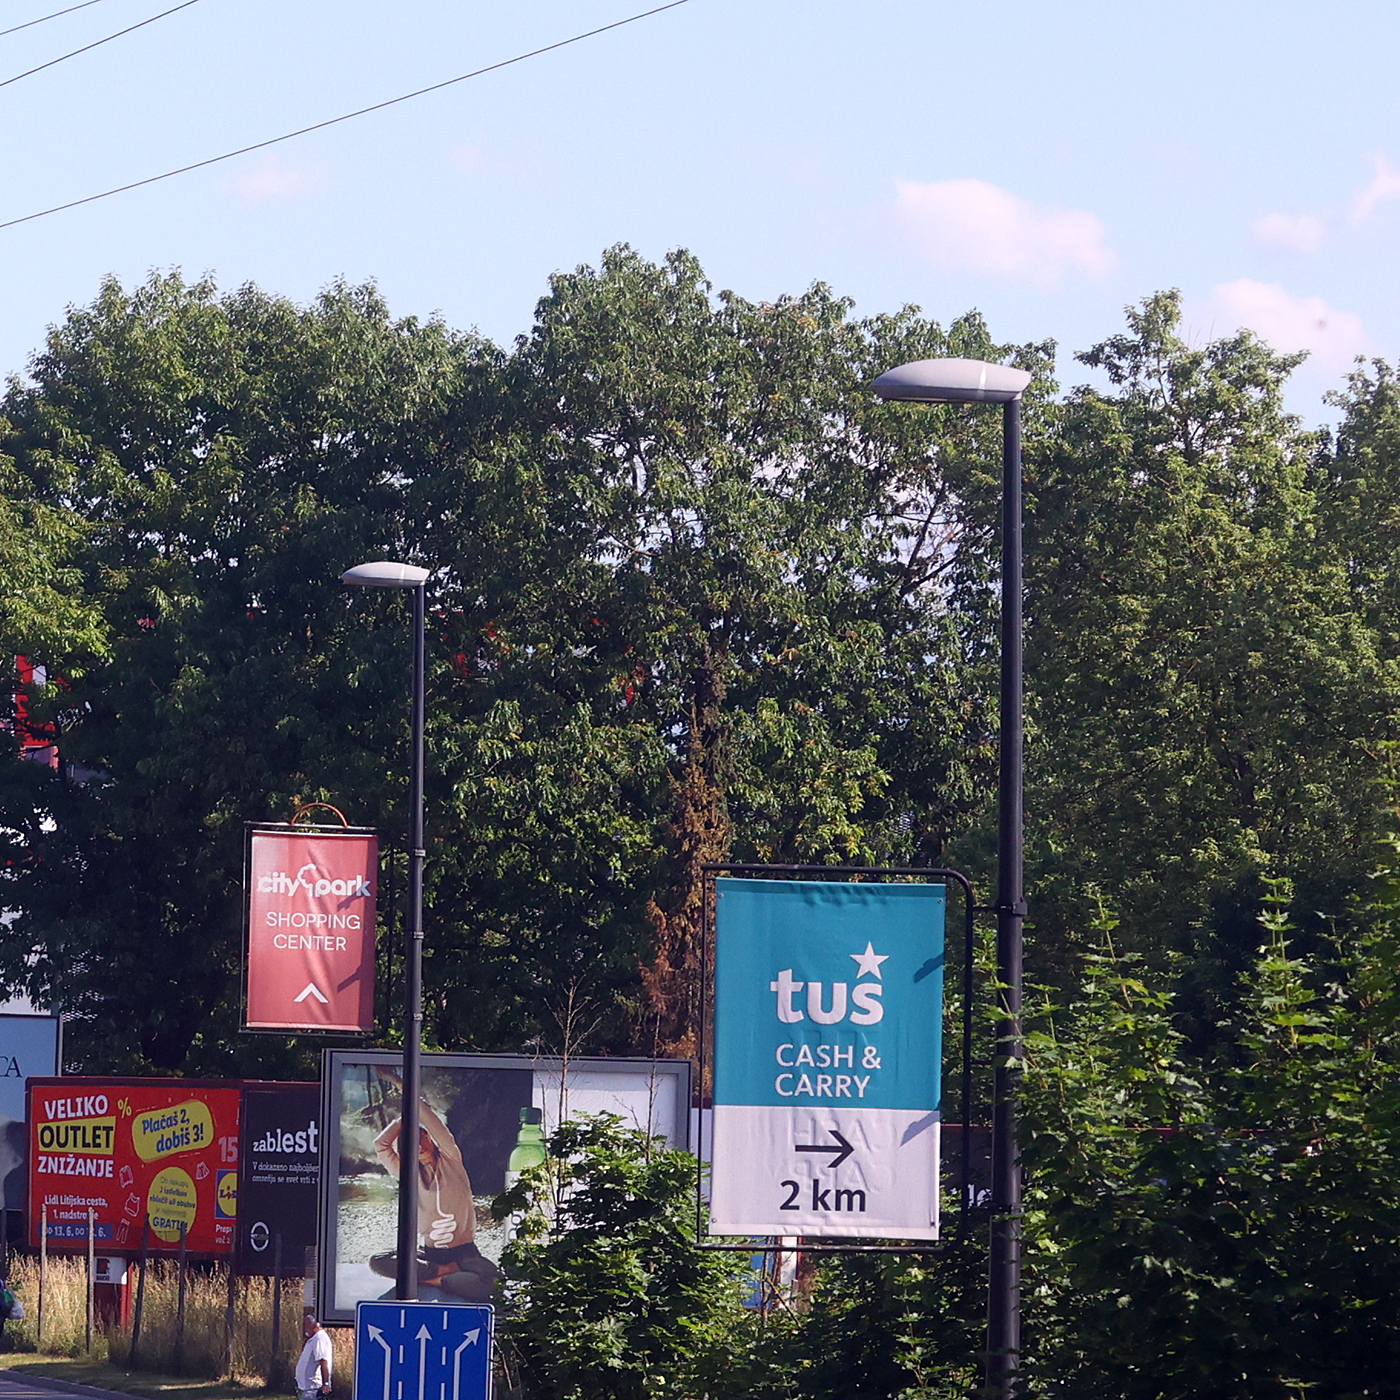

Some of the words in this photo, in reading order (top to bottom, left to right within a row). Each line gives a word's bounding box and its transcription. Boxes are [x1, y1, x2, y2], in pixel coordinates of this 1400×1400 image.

[266, 911, 361, 930] SHOPPING
[273, 934, 347, 951] CENTER
[775, 1043, 854, 1069] CASH
[861, 1046, 882, 1069] &
[774, 1073, 871, 1099] CARRY
[44, 1094, 109, 1120] VELIKO
[117, 1096, 132, 1119] %
[141, 1111, 179, 1135] Plačaš
[180, 1108, 191, 1124] 2,
[40, 1125, 114, 1149] OUTLET
[156, 1126, 191, 1153] dobiš
[192, 1122, 205, 1143] 3!
[253, 1120, 319, 1154] zablest
[37, 1154, 114, 1178] ZNIŽANJE
[44, 1194, 59, 1205] Lidl
[60, 1194, 86, 1207] Litijska
[779, 1180, 800, 1211] 2
[812, 1179, 867, 1212] km
[54, 1226, 65, 1237] 13.
[66, 1226, 74, 1237] 6.
